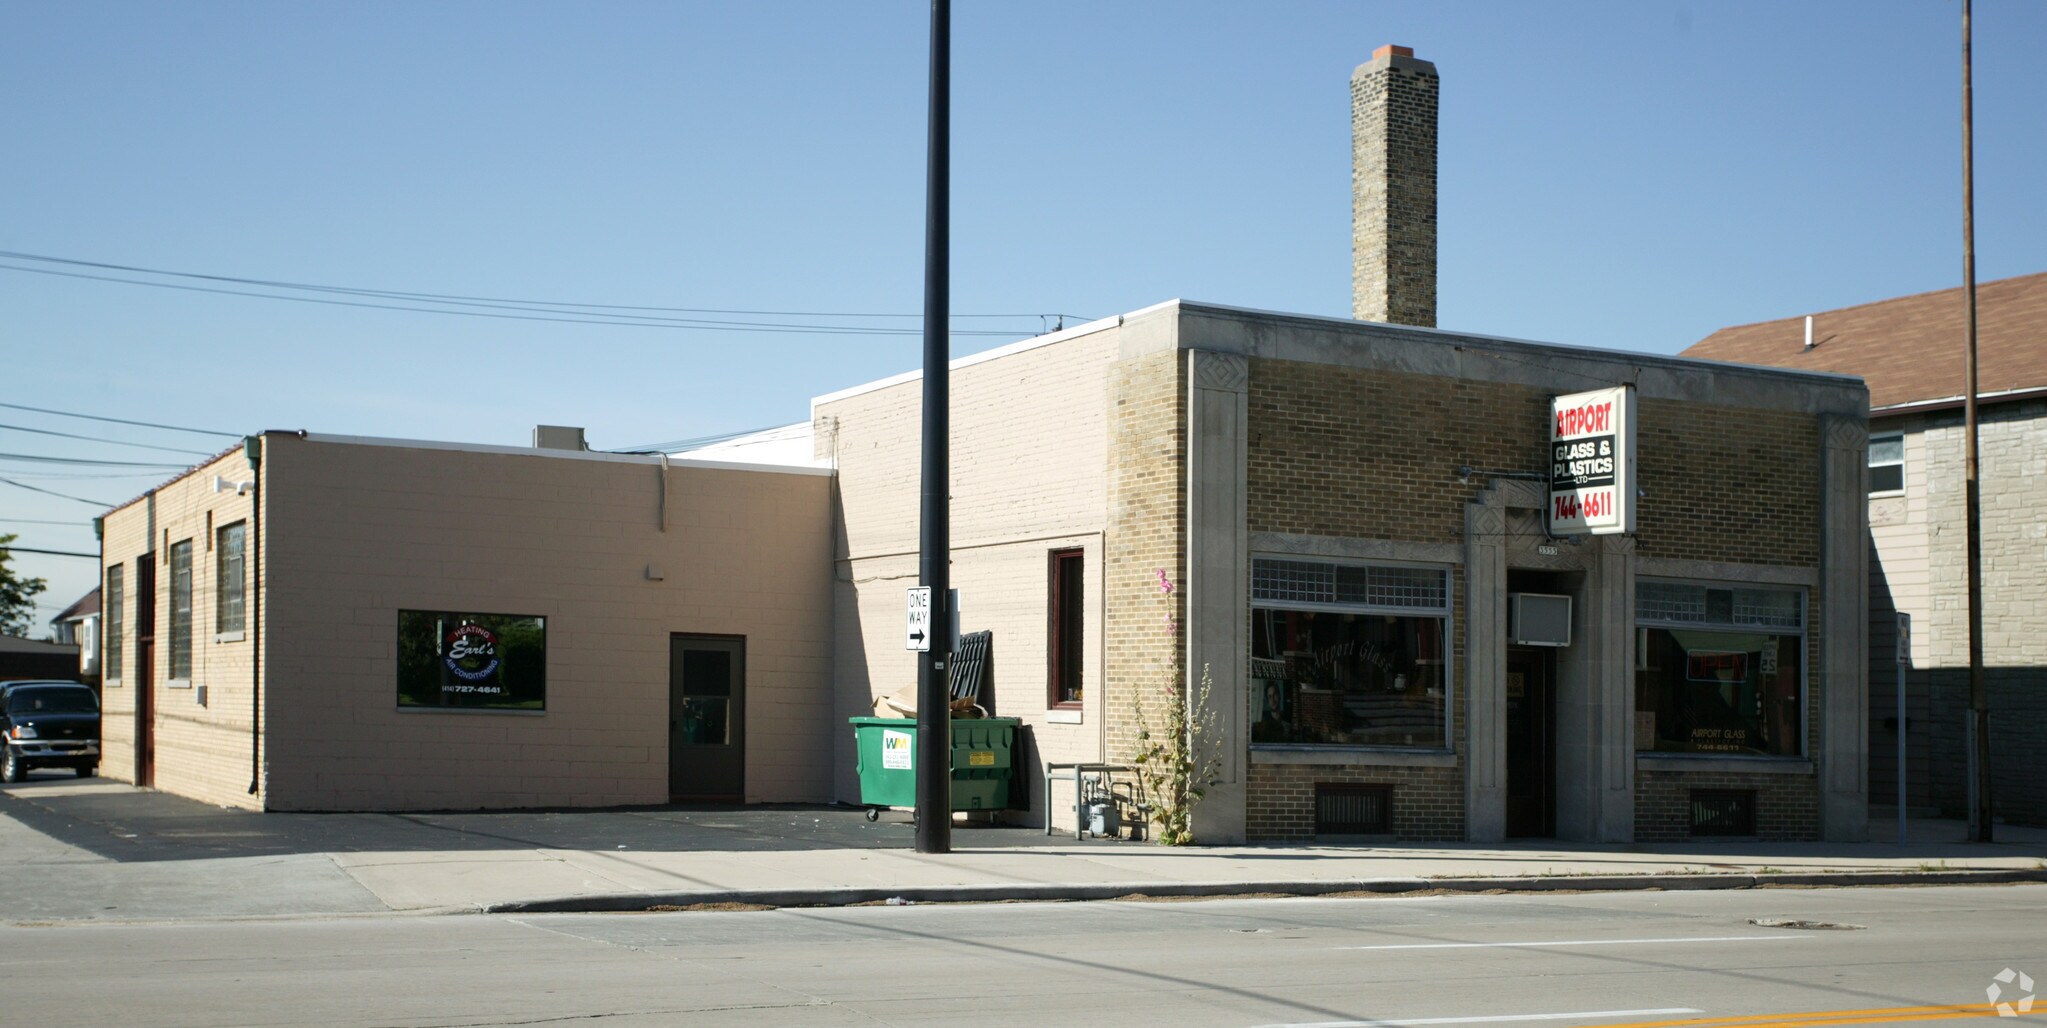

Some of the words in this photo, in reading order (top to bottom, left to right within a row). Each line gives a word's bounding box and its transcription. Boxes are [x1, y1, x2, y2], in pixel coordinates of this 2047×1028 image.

[1556, 402, 1611, 437] AIRPORT
[1555, 442, 1595, 461] GLASS
[1599, 440, 1611, 456] &
[1554, 457, 1613, 478] PLASTICS
[1575, 475, 1588, 484] LTD
[1555, 492, 1611, 520] 744-6611
[909, 593, 927, 608] ONE
[909, 611, 928, 625] WAY
[454, 626, 490, 638] HEATING
[449, 640, 495, 659] Earl's
[1312, 640, 1354, 675] Airport
[1359, 641, 1392, 673] Glass
[446, 658, 456, 670] AIR
[454, 659, 498, 680] CONDITIONING
[1689, 652, 1746, 680] OPEN
[885, 737, 908, 750] WM
[1691, 728, 1722, 738] AIRPORT
[1724, 729, 1746, 739] GLASS
